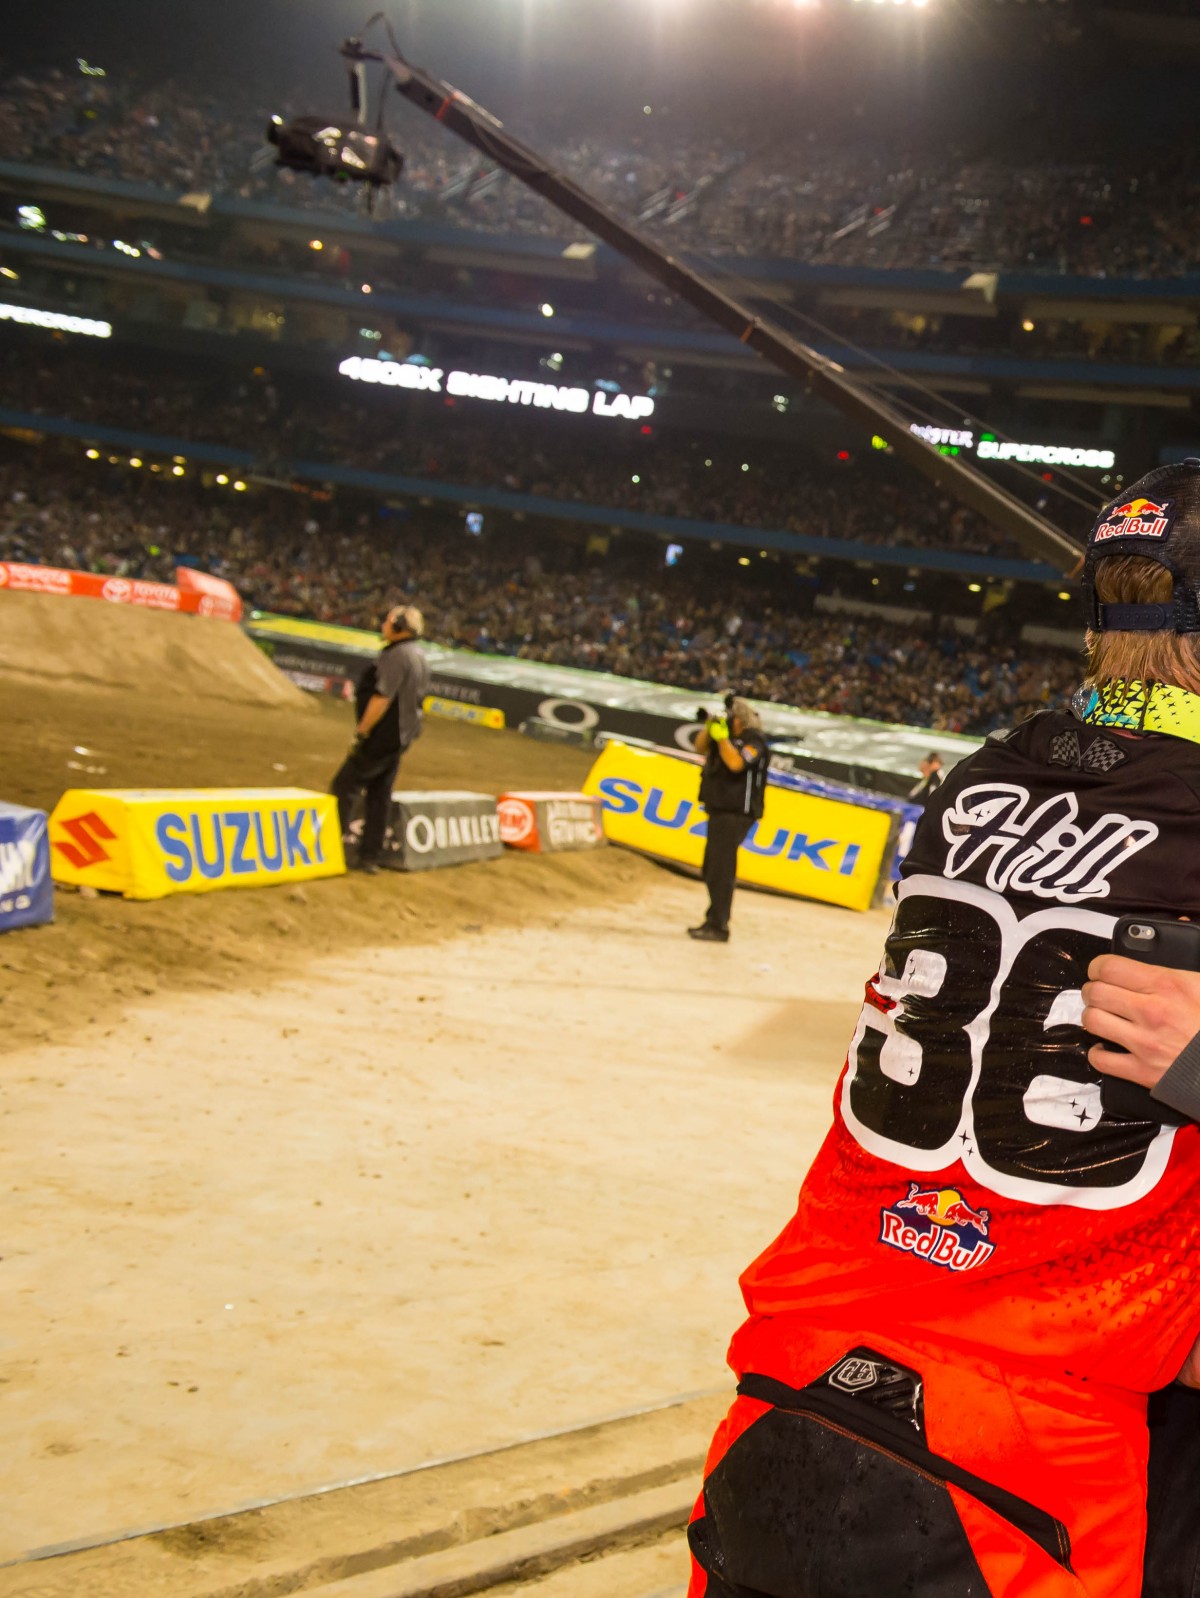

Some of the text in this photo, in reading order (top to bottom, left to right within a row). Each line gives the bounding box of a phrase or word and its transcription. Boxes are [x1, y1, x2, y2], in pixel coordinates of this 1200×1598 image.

[338, 356, 654, 419] 450SX SIGHTING LAP
[977, 441, 1115, 468] SUPERCROSS
[1094, 517, 1168, 543] Red Bull
[132, 582, 179, 602] TOYOTA
[156, 809, 325, 883] SUZUKI
[434, 814, 500, 848] OAKLEY
[599, 777, 861, 876] SUUKI
[942, 783, 1159, 902] Hill
[881, 1210, 995, 1271] Red Bull
